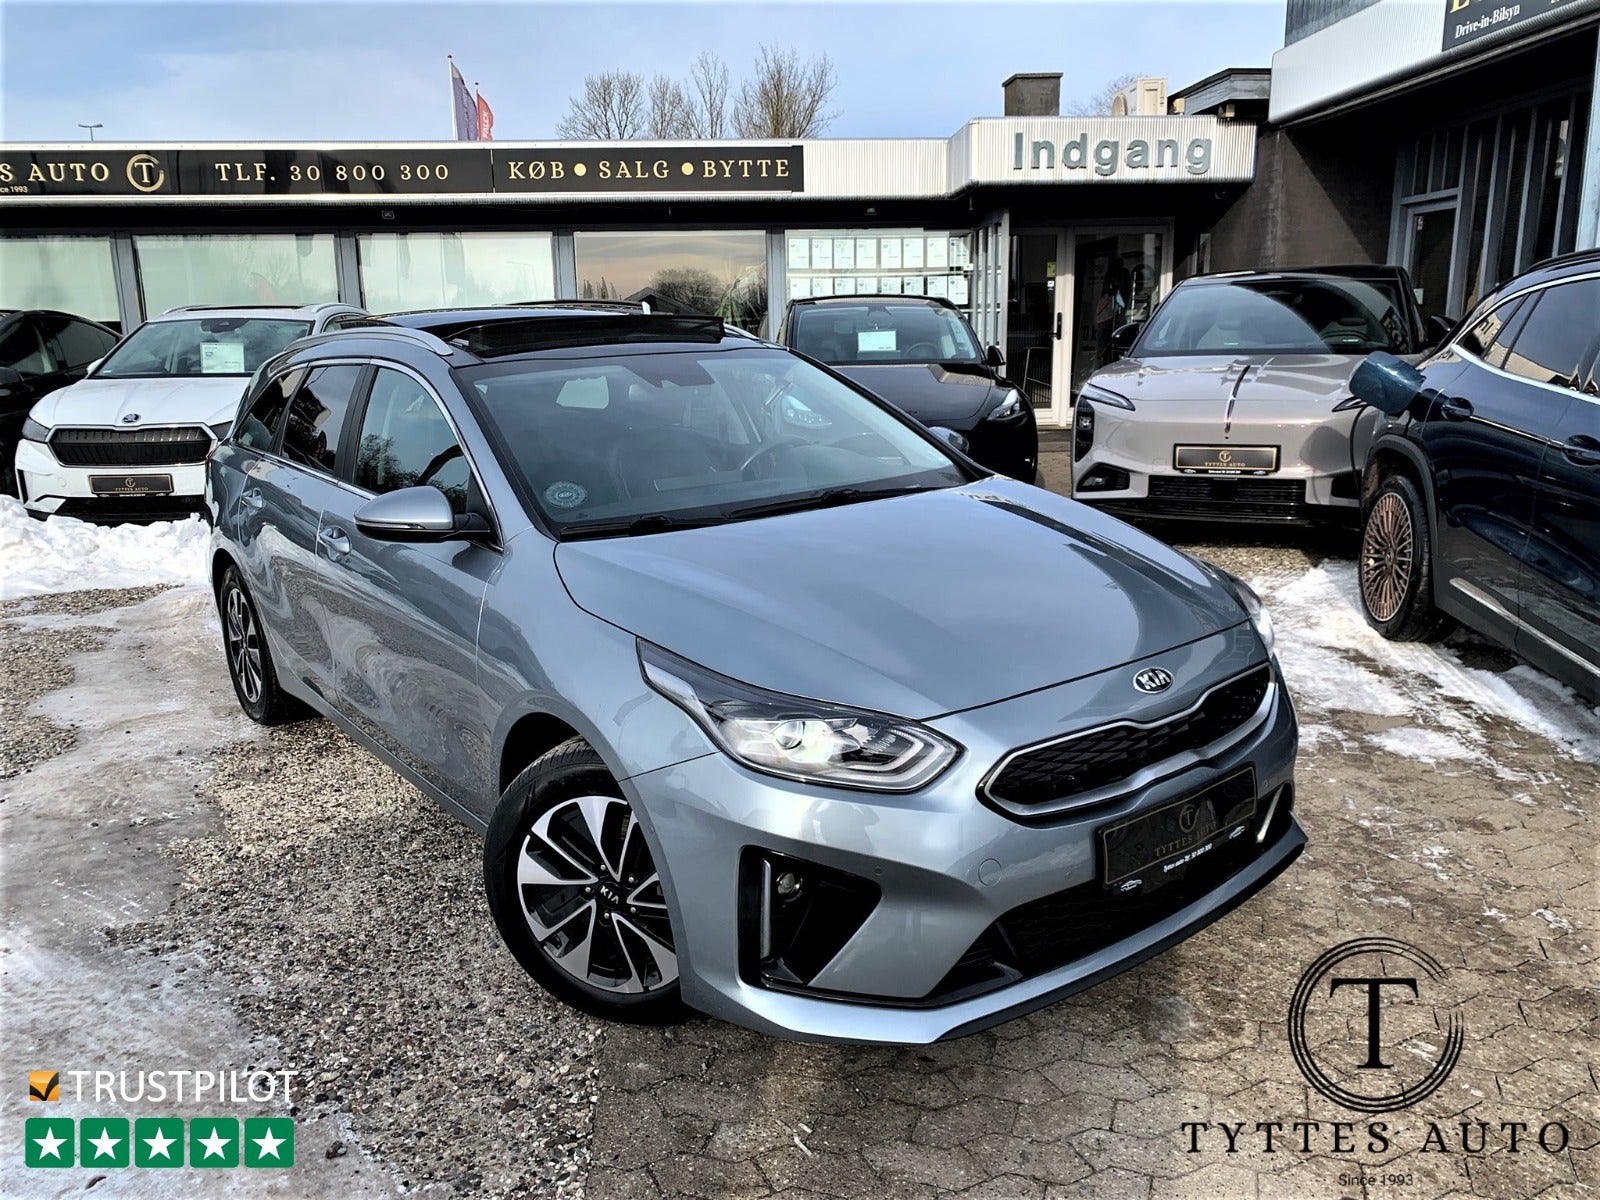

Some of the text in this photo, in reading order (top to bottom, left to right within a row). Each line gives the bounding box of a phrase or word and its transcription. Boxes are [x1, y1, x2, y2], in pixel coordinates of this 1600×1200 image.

[1455, 4, 1520, 39] Drive-in-Bilsyn
[1013, 132, 1212, 176] Indgang
[28, 163, 109, 182] AUTO
[215, 163, 449, 181] TLF. 30 800 300
[508, 159, 790, 180] KØB SALG BYTTE
[10, 185, 28, 193] 1993
[1138, 670, 1171, 690] KIA
[1155, 835, 1192, 857] TYTTES
[600, 885, 619, 904] KIA
